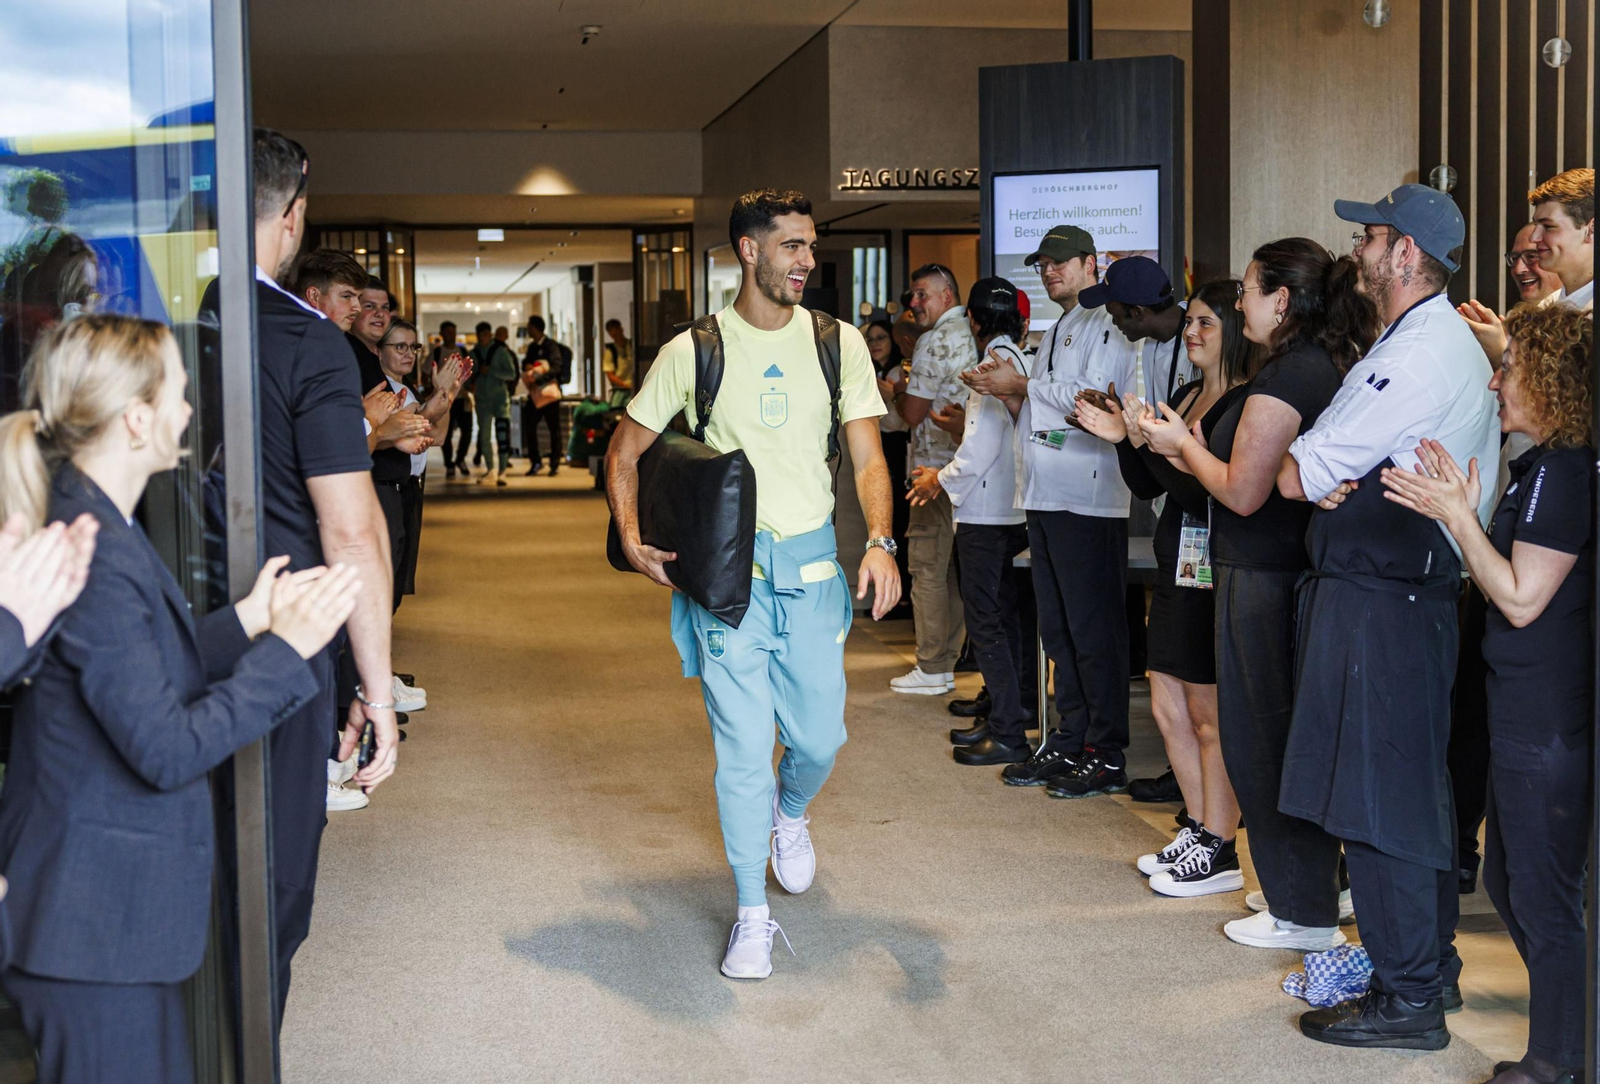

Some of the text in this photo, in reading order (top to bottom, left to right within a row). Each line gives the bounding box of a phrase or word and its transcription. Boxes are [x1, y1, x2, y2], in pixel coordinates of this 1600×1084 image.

[844, 169, 979, 189] TAGUNGSZ
[1009, 204, 1143, 221] Herzlich willkommen!
